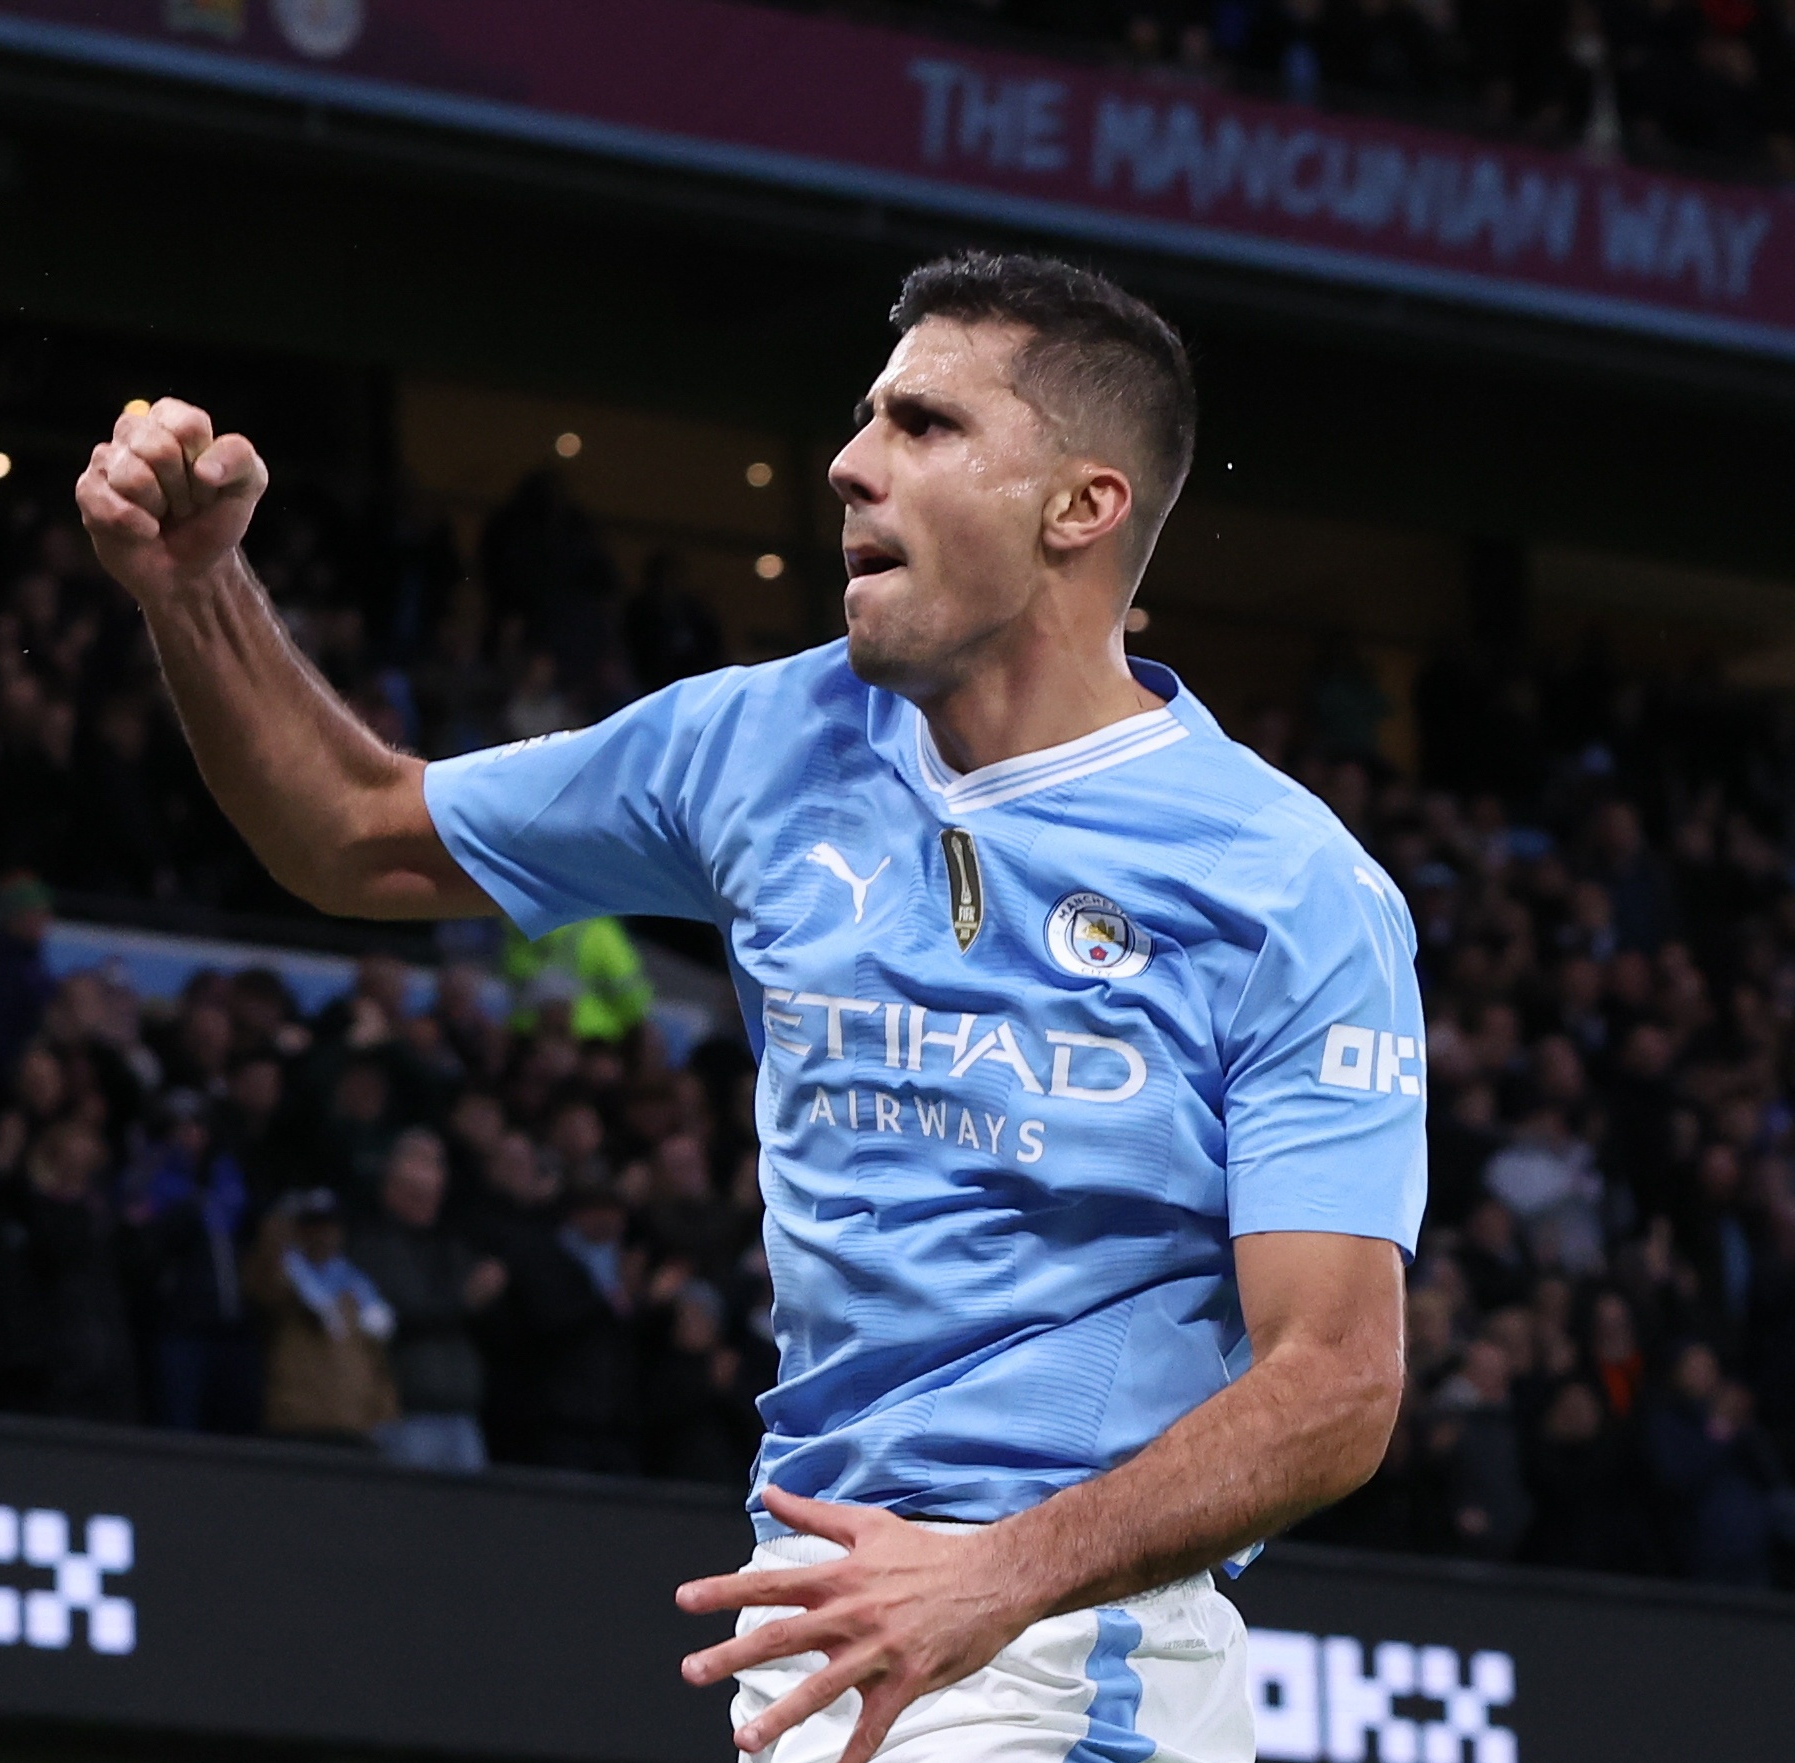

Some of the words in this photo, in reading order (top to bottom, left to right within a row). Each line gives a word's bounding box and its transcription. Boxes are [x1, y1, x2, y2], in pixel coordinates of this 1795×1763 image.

[907, 58, 1068, 172] THE
[1092, 93, 1578, 262] MANCUNIAN
[1600, 184, 1770, 300] WAY
[763, 987, 1147, 1103] ETIHAD
[1319, 1022, 1426, 1097] OK
[808, 1086, 1046, 1164] AIRWAYS
